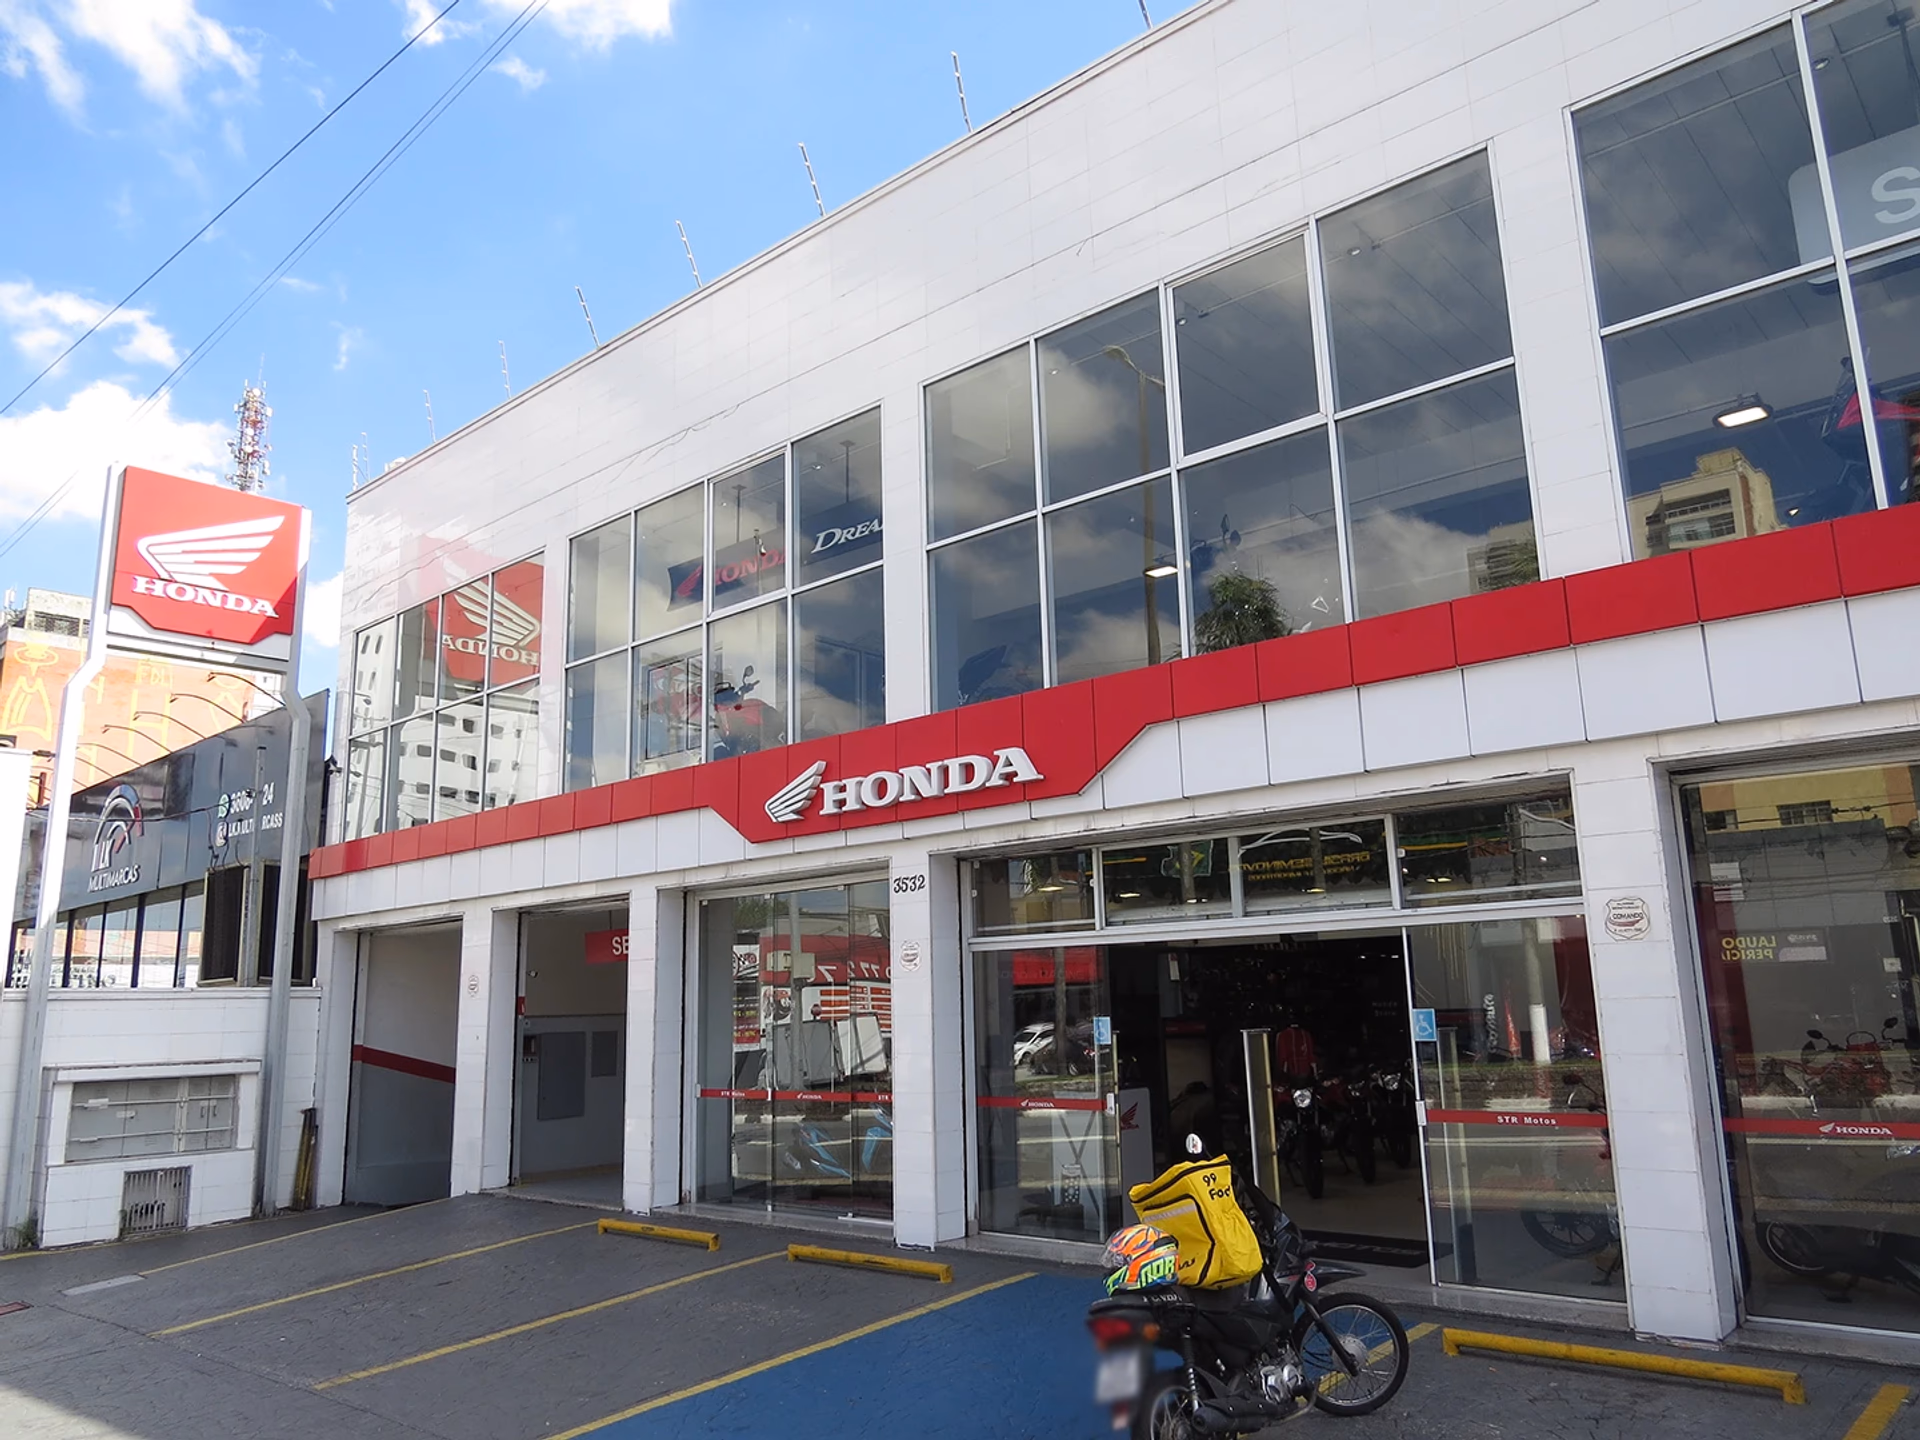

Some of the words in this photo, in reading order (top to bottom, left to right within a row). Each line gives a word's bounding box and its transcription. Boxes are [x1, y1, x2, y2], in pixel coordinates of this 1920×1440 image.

[132, 575, 279, 618] HONDA
[819, 747, 1044, 815] HONDA
[893, 873, 926, 894] 3532
[1497, 1115, 1519, 1124] STR
[1523, 1116, 1557, 1126] Motos
[1835, 1126, 1893, 1135] HONDA
[1202, 1172, 1217, 1187] 99
